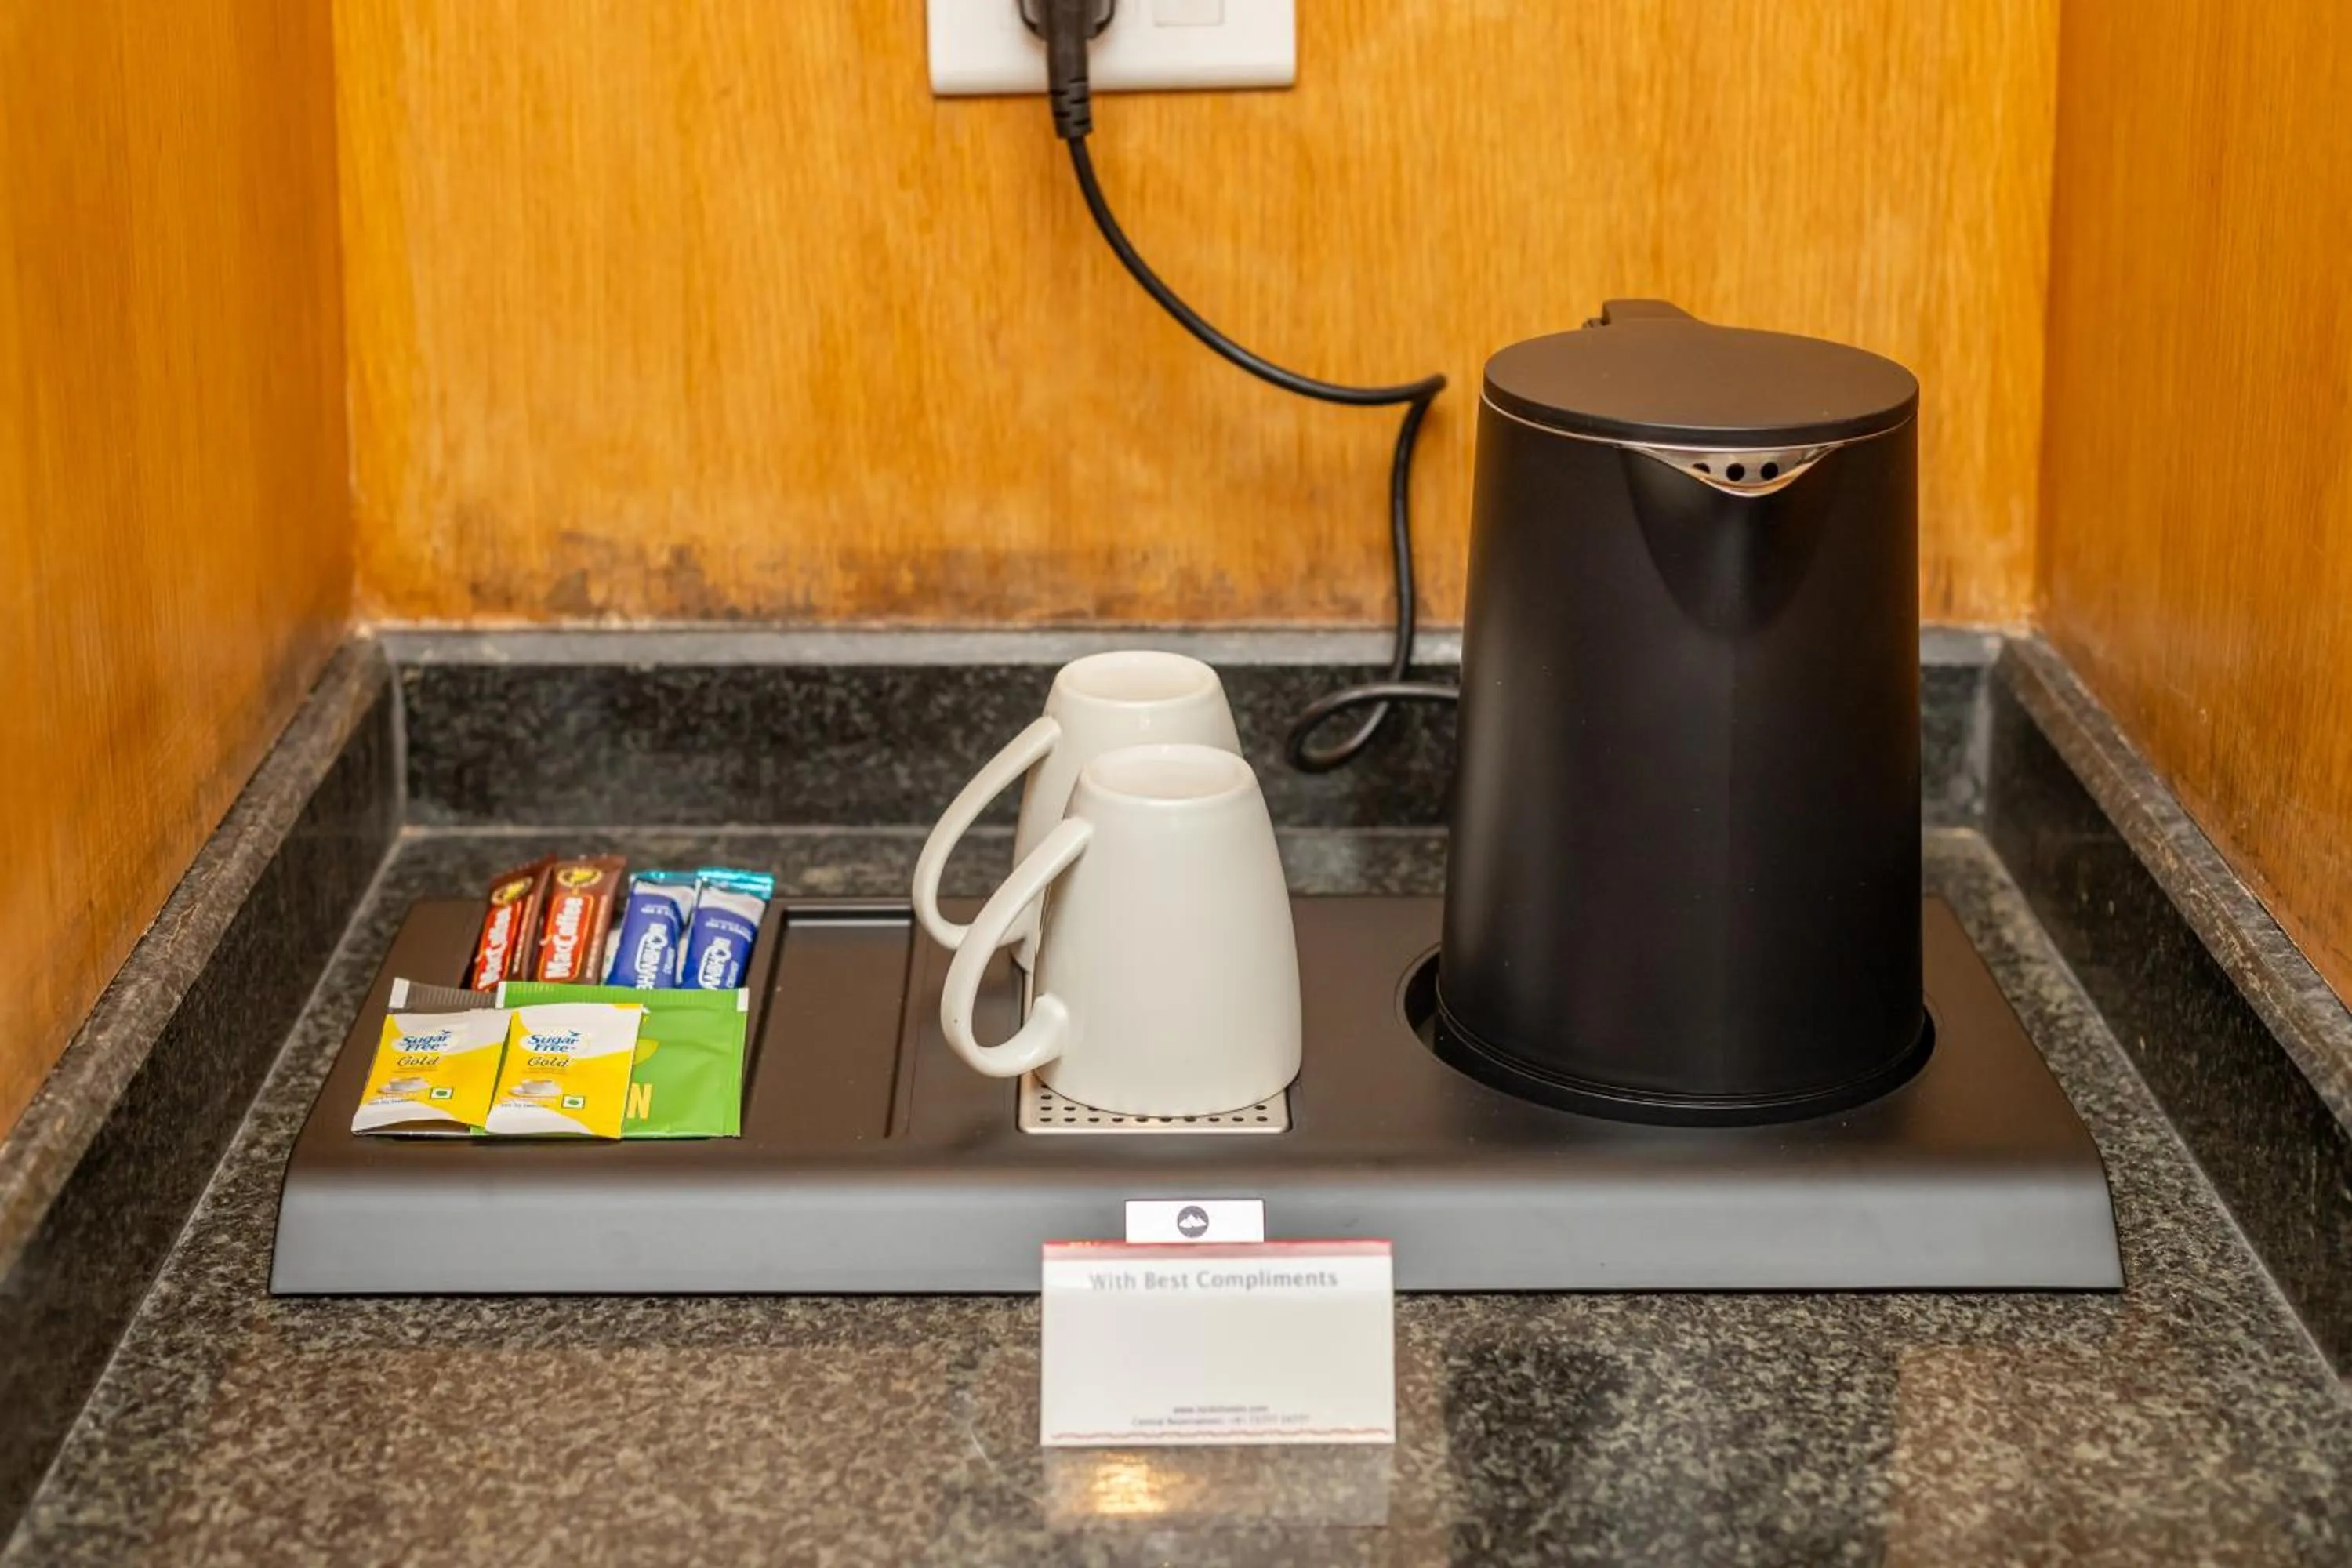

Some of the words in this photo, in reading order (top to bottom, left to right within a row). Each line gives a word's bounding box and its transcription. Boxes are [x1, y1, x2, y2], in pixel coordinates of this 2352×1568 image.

[402, 1033, 449, 1045] Sugar
[526, 1033, 580, 1045] Sugar
[404, 1042, 441, 1052] Free
[532, 1043, 570, 1053] Free
[397, 1055, 440, 1067] Gold
[527, 1055, 571, 1067] Gold
[1089, 1271, 1137, 1291] With
[1144, 1271, 1189, 1290] Best
[1196, 1269, 1339, 1291] Compliments
